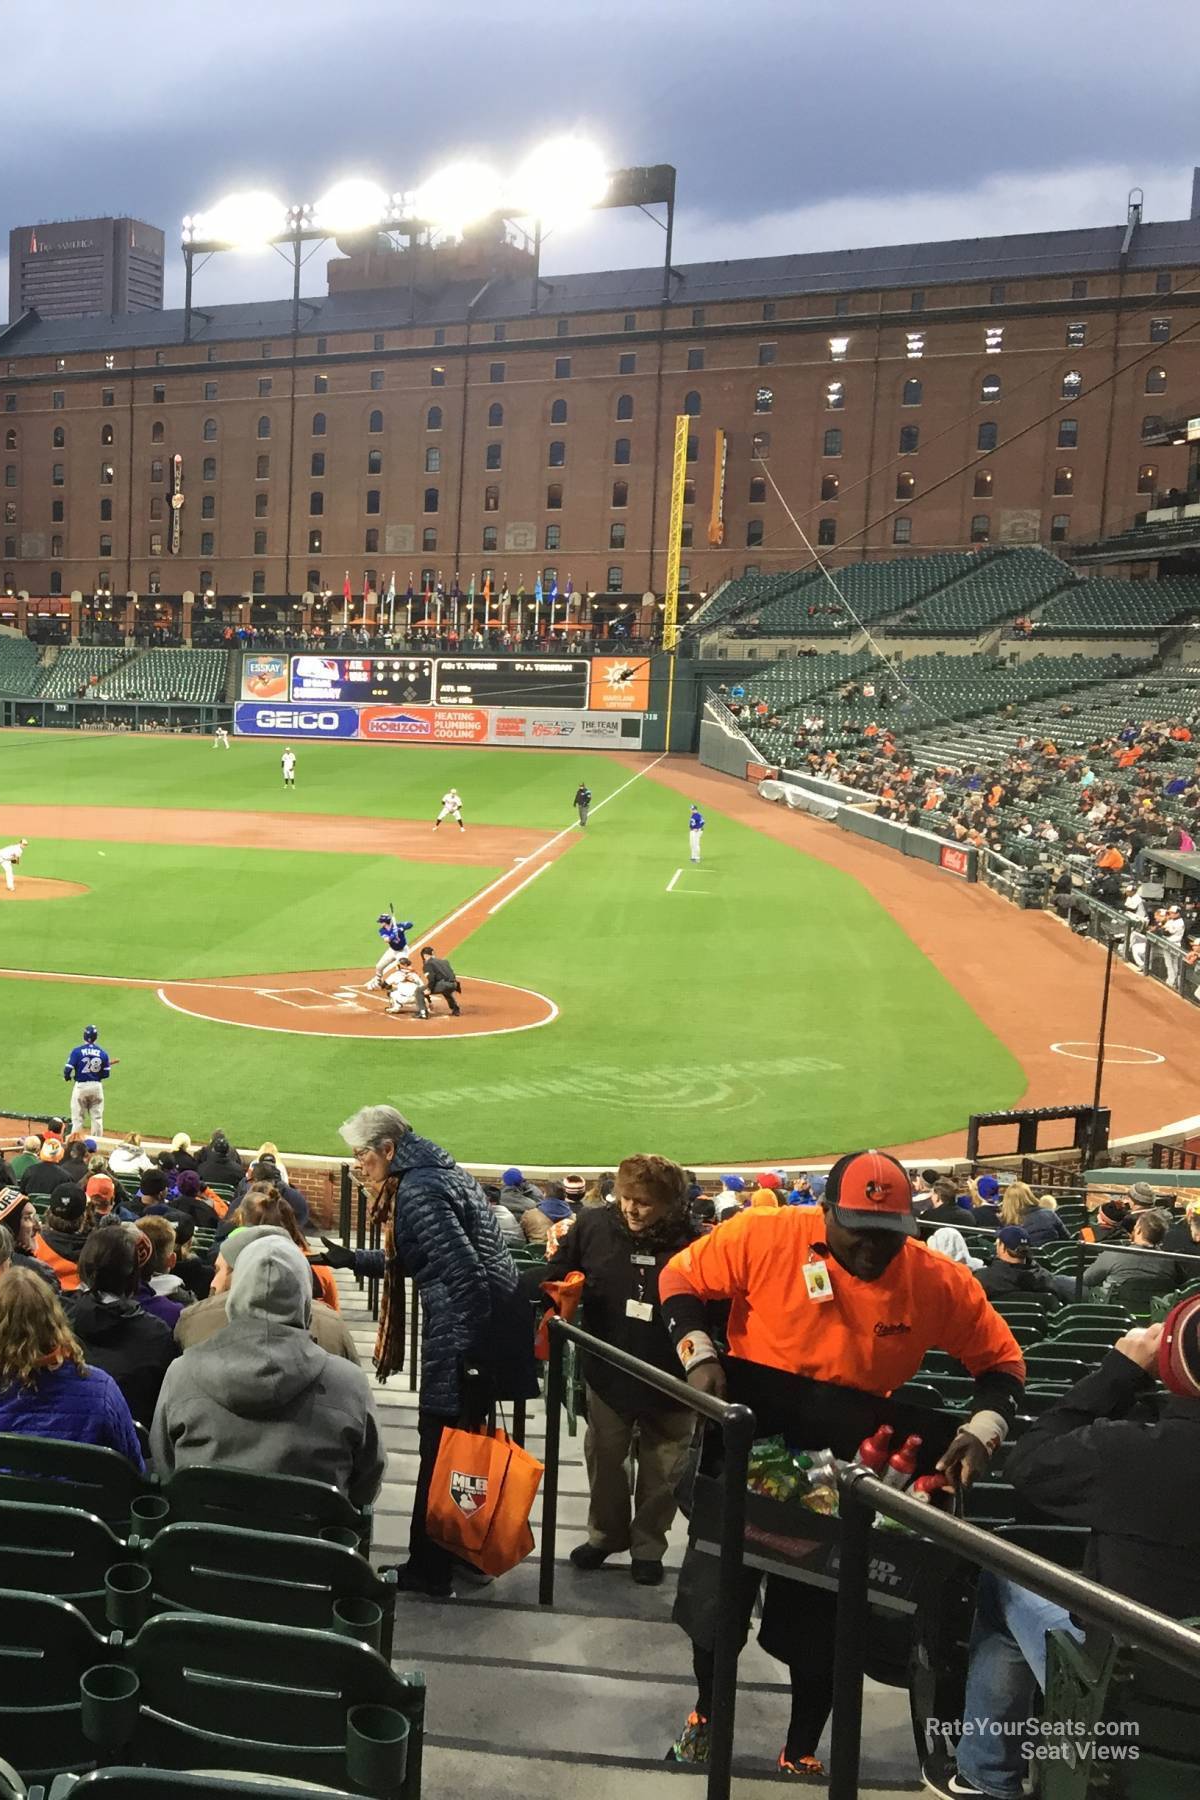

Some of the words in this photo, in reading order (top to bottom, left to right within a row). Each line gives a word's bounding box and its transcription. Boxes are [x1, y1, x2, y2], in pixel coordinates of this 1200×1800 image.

[250, 663, 280, 673] ESSKAY
[256, 711, 339, 730] GEICO
[434, 711, 475, 721] HEATING
[370, 721, 430, 733] HORIZON
[434, 721, 482, 730] PLUMBING
[597, 721, 618, 731] TEAM
[434, 729, 474, 739] COOLING
[81, 1057, 102, 1073] 28
[452, 1472, 488, 1491] MLB
